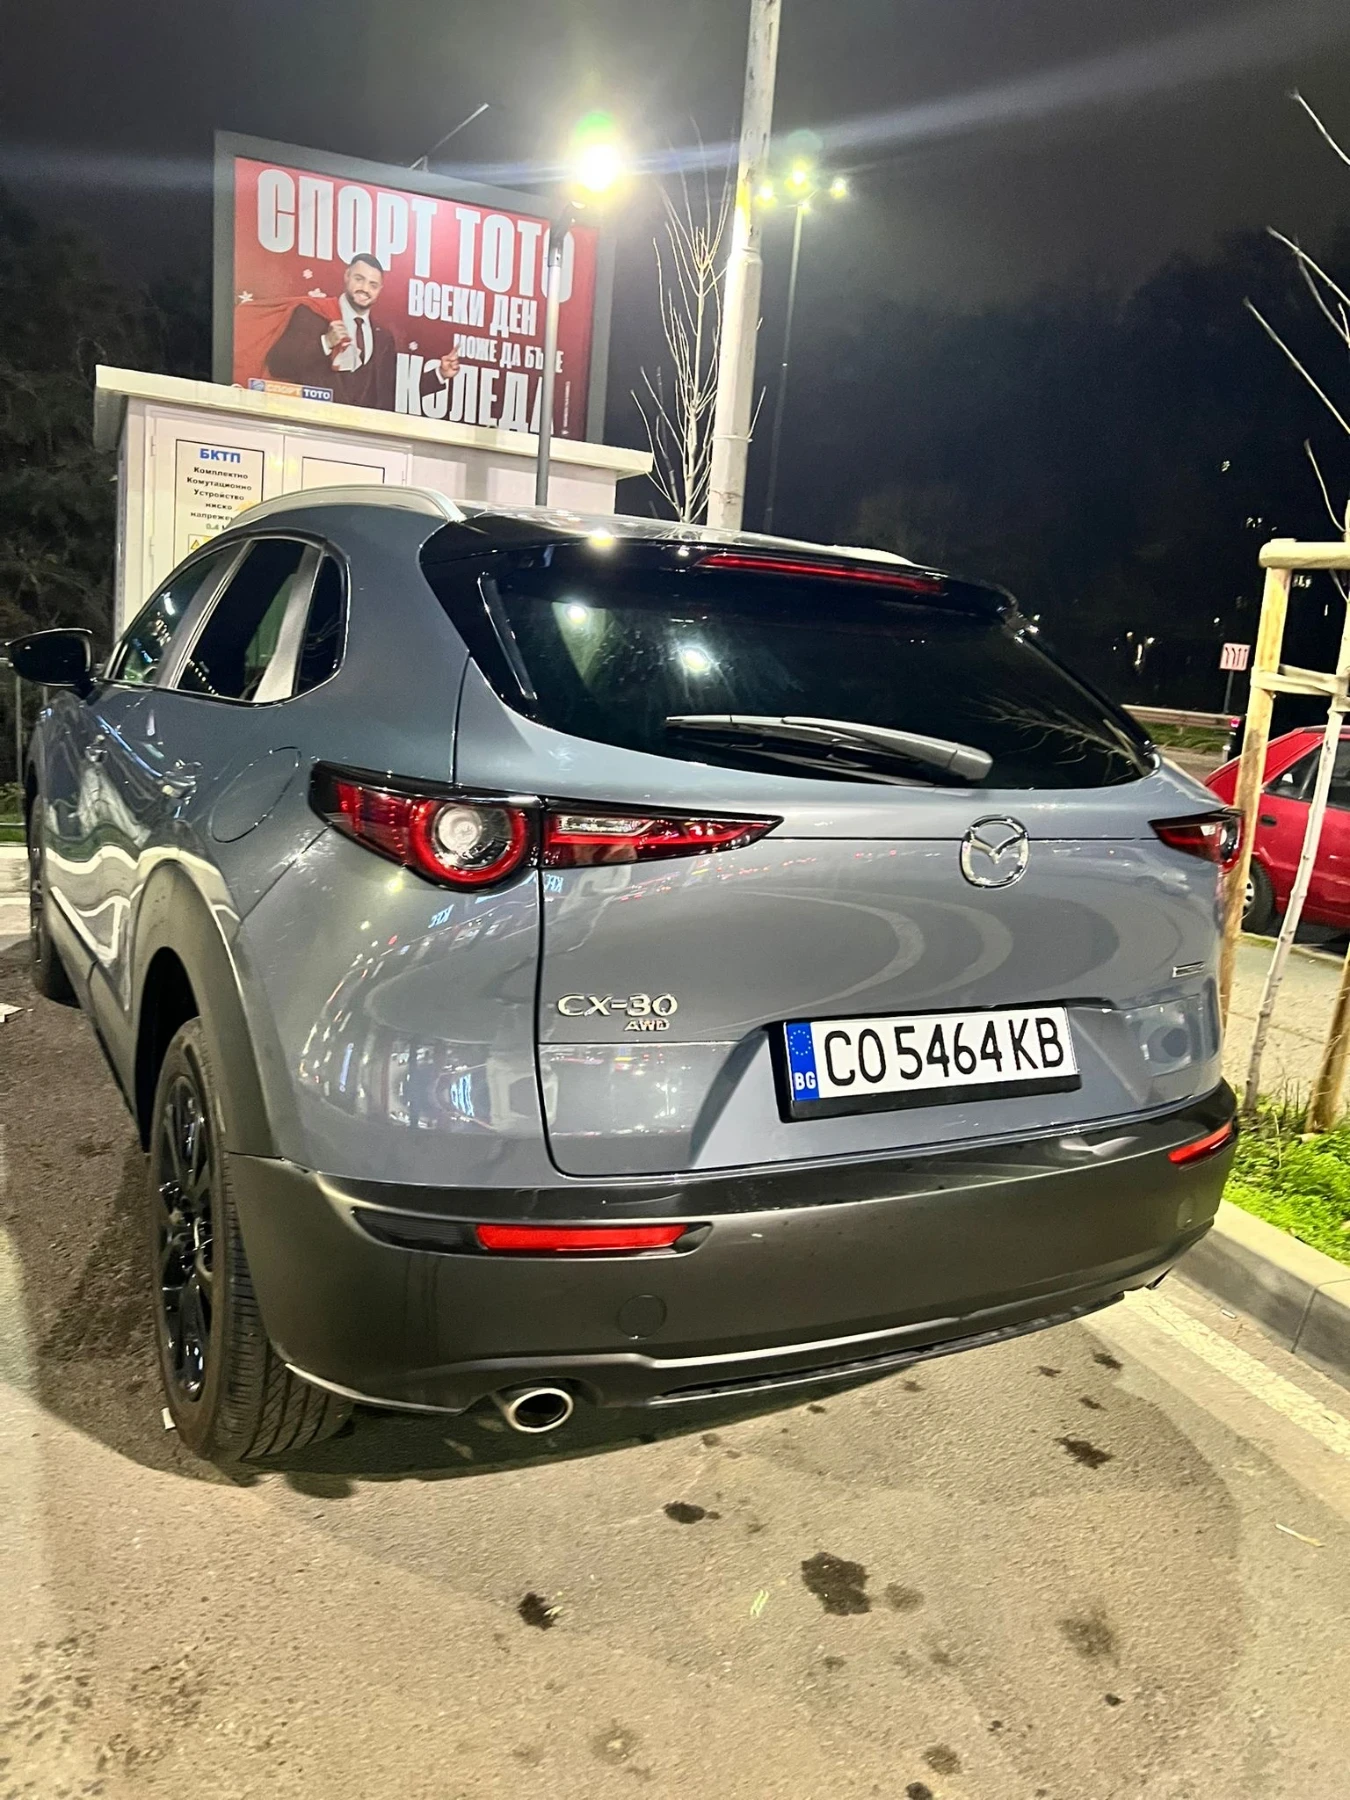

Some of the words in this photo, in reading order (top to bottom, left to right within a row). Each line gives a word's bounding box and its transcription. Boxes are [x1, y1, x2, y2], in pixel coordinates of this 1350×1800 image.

[257, 169, 438, 279] СПОРТ
[455, 207, 575, 303] ТОТО
[408, 278, 486, 328] ВСЕКИ
[489, 293, 538, 338] ДЕН
[453, 333, 498, 363] МОЖЕ
[500, 341, 522, 369] ДА
[524, 345, 564, 374] БЪЕ
[303, 388, 331, 400] ТОТО
[200, 448, 241, 463] БКТП
[193, 466, 248, 479] Комплектно
[186, 476, 252, 490] Комутационно
[193, 488, 244, 500] Устройство
[205, 502, 233, 510] ниско
[557, 992, 679, 1017] CX-30
[624, 1018, 671, 1032] AWD
[794, 1071, 817, 1091] BG
